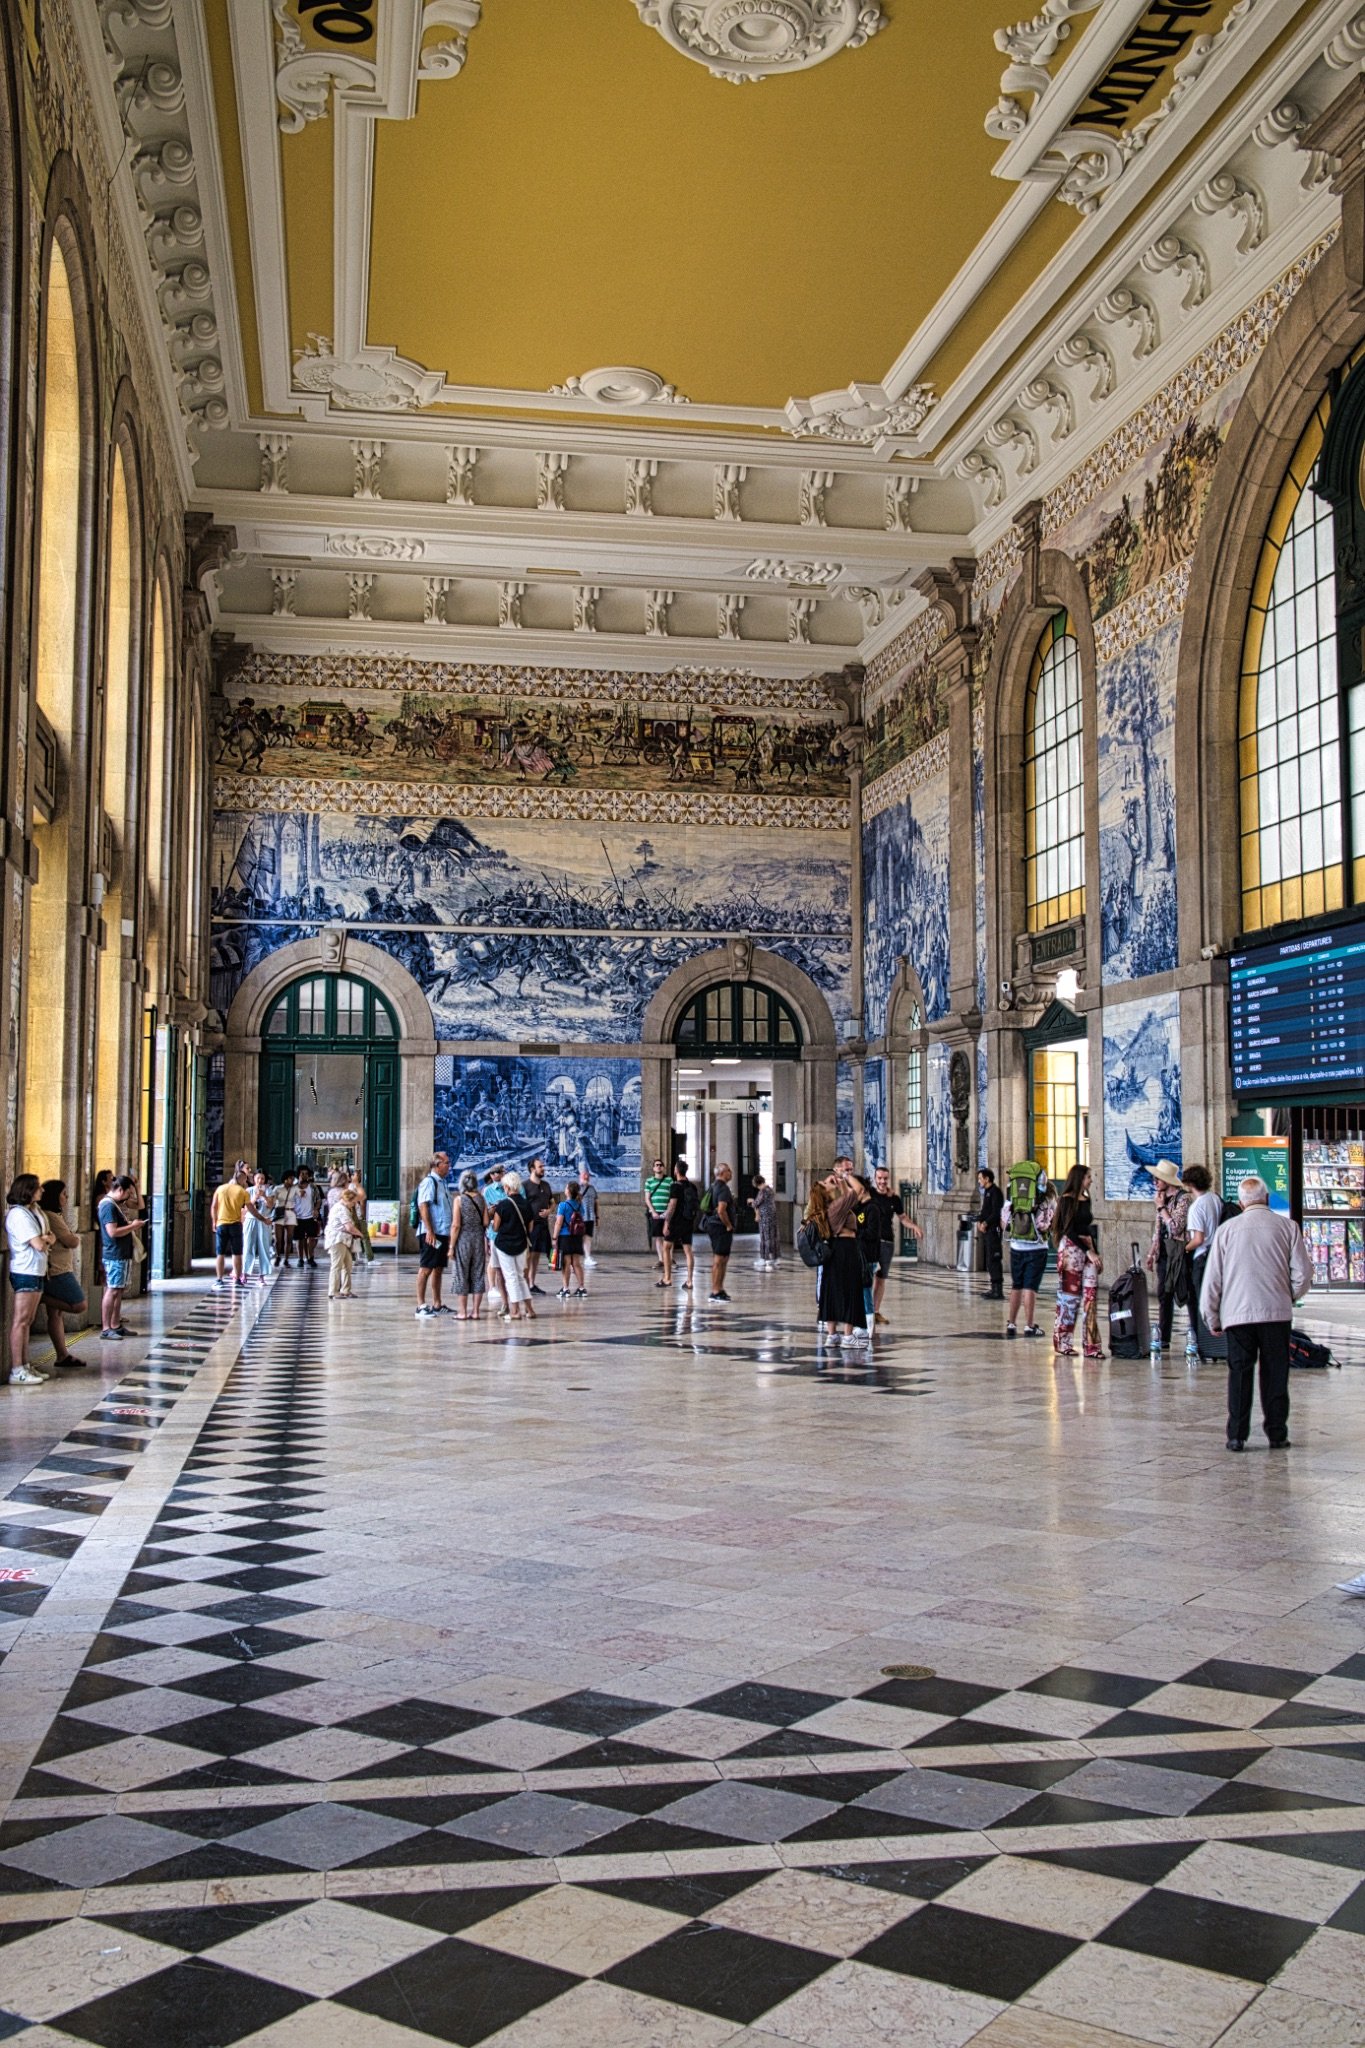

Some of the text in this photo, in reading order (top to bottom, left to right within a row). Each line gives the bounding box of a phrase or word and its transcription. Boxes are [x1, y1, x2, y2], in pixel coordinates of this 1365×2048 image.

[1070, 0, 1213, 129] MINH
[1035, 931, 1074, 959] ENTRADA
[1280, 943, 1300, 955] PARTIDAS
[1303, 936, 1332, 950] DEPARTURES
[312, 1131, 358, 1140] RONYMO
